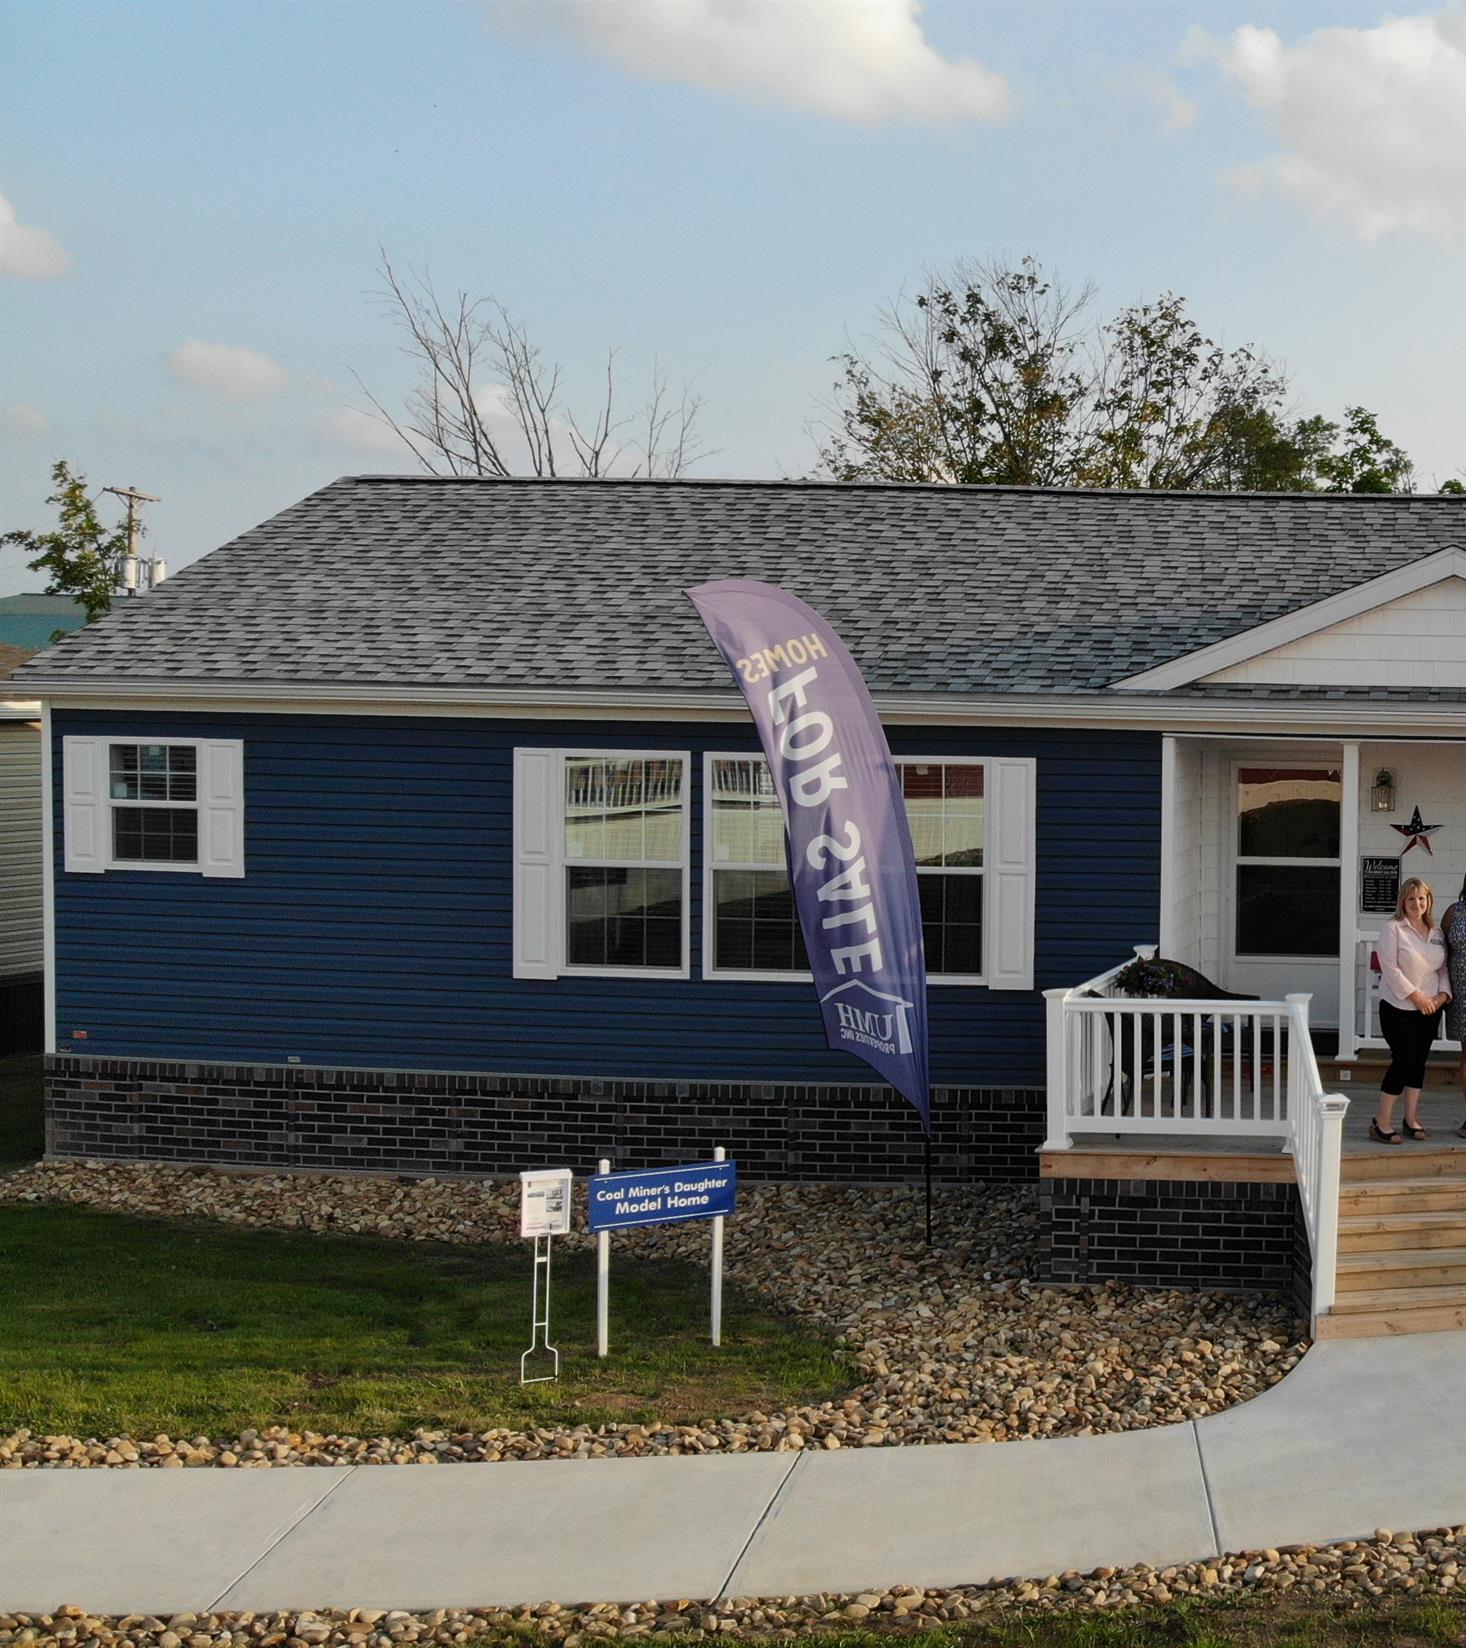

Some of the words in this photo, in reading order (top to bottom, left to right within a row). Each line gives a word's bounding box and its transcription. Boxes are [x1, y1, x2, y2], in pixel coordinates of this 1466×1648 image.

[1365, 860, 1398, 870] Welcome
[597, 1188, 624, 1202] Coal
[628, 1184, 670, 1198] Miner's
[674, 1178, 728, 1192] Daughter
[615, 1197, 662, 1215] Model
[667, 1195, 710, 1209] Home
